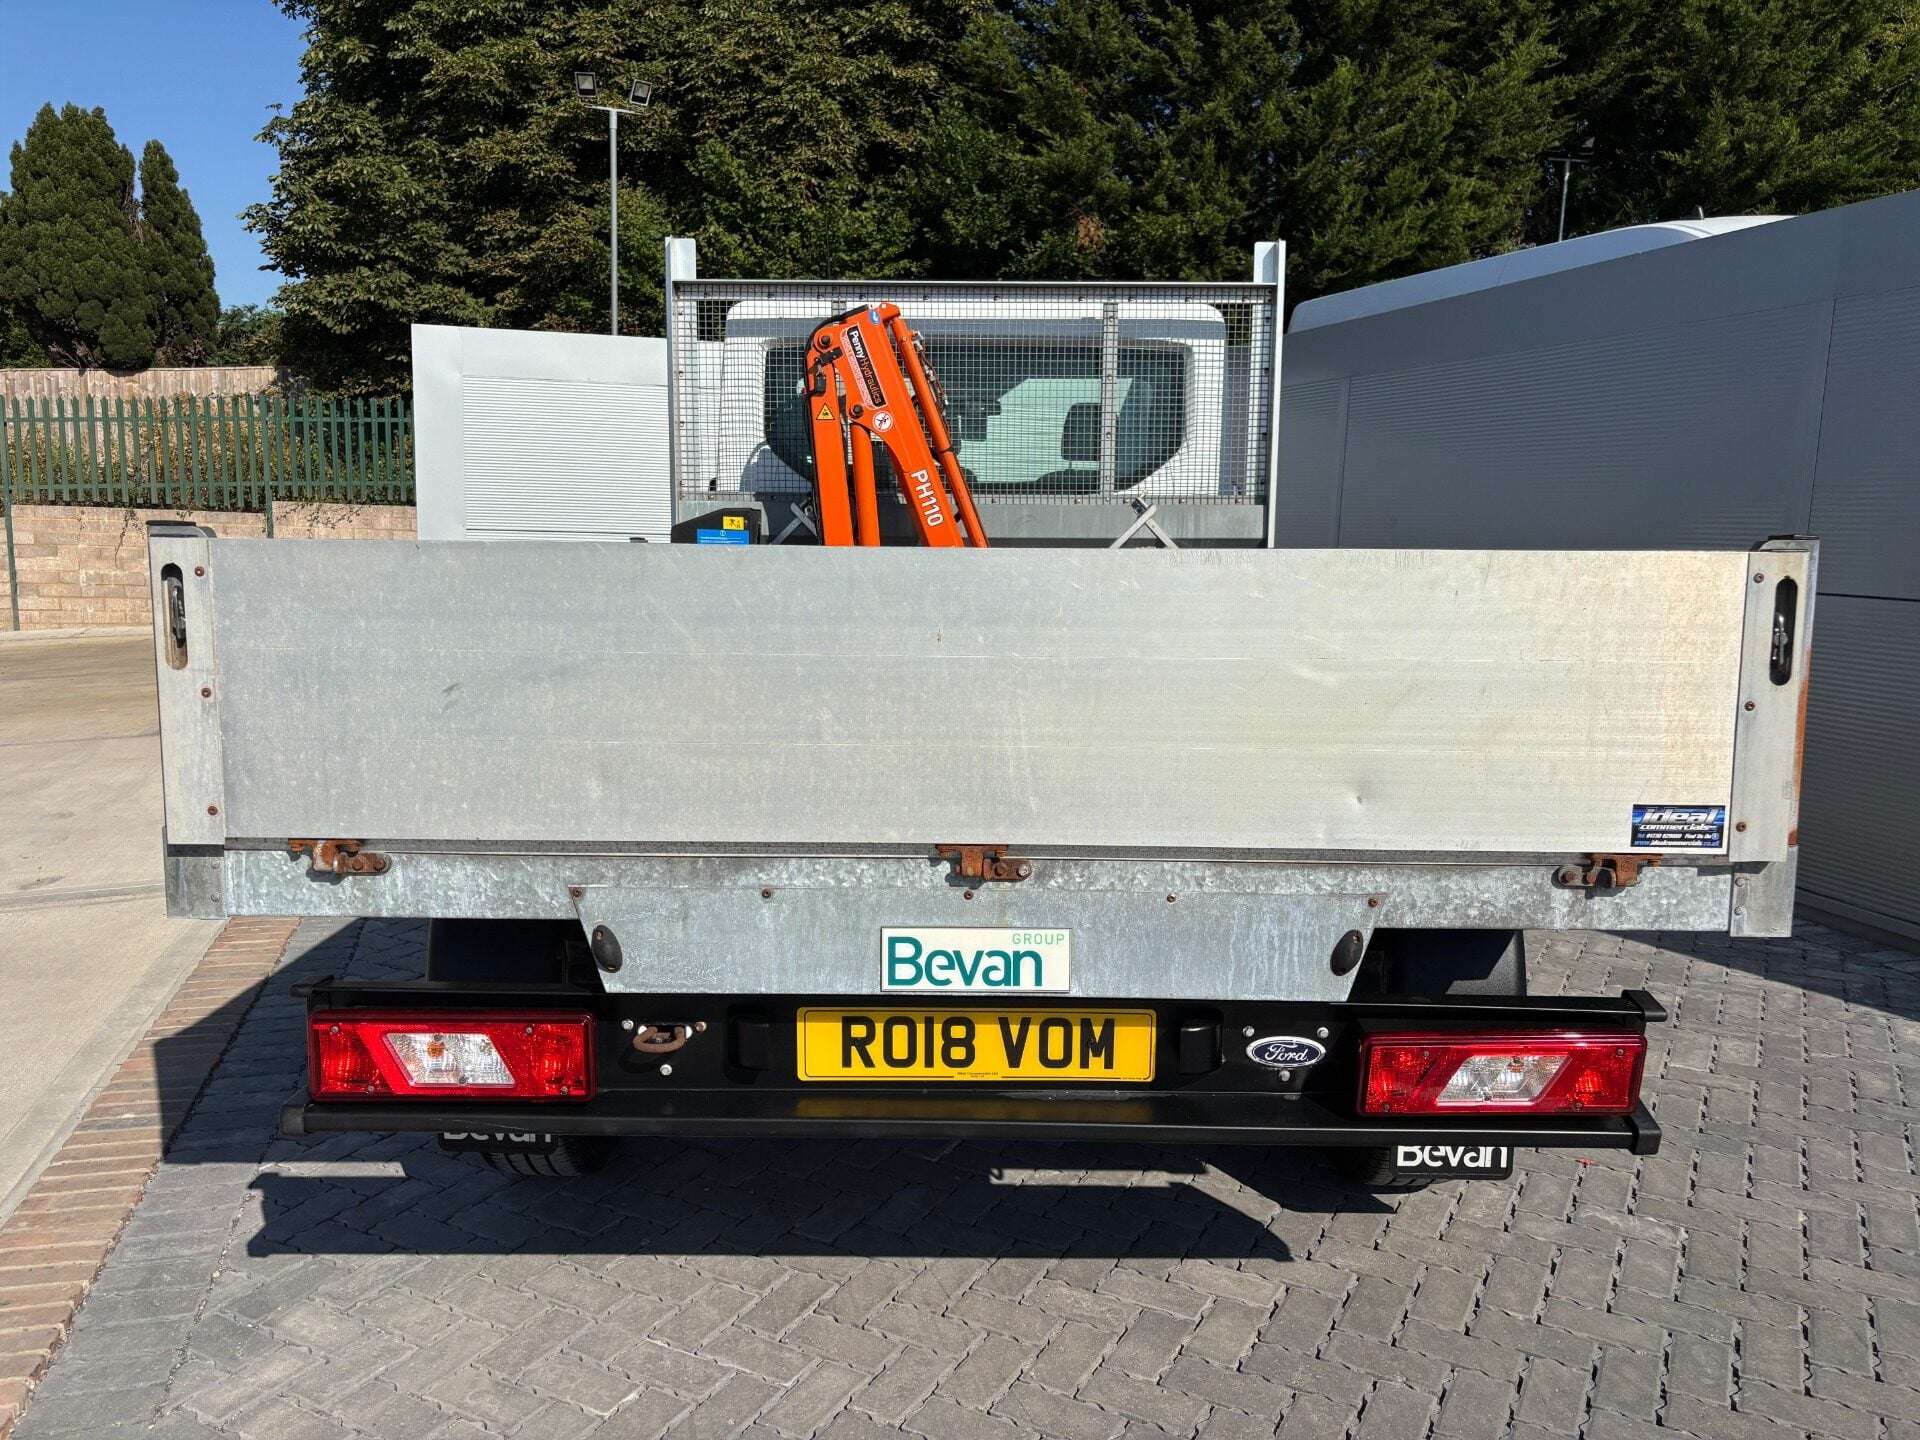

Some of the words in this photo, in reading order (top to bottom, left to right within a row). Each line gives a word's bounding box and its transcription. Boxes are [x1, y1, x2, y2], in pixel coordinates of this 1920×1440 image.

[911, 469, 944, 527] PH110
[1642, 808, 1717, 823] ideal
[1012, 933, 1065, 946] GROUP
[887, 936, 1043, 987] Bevan
[841, 1015, 976, 1069] RO18
[997, 1016, 1115, 1070] VOM
[1265, 1043, 1309, 1062] Ford
